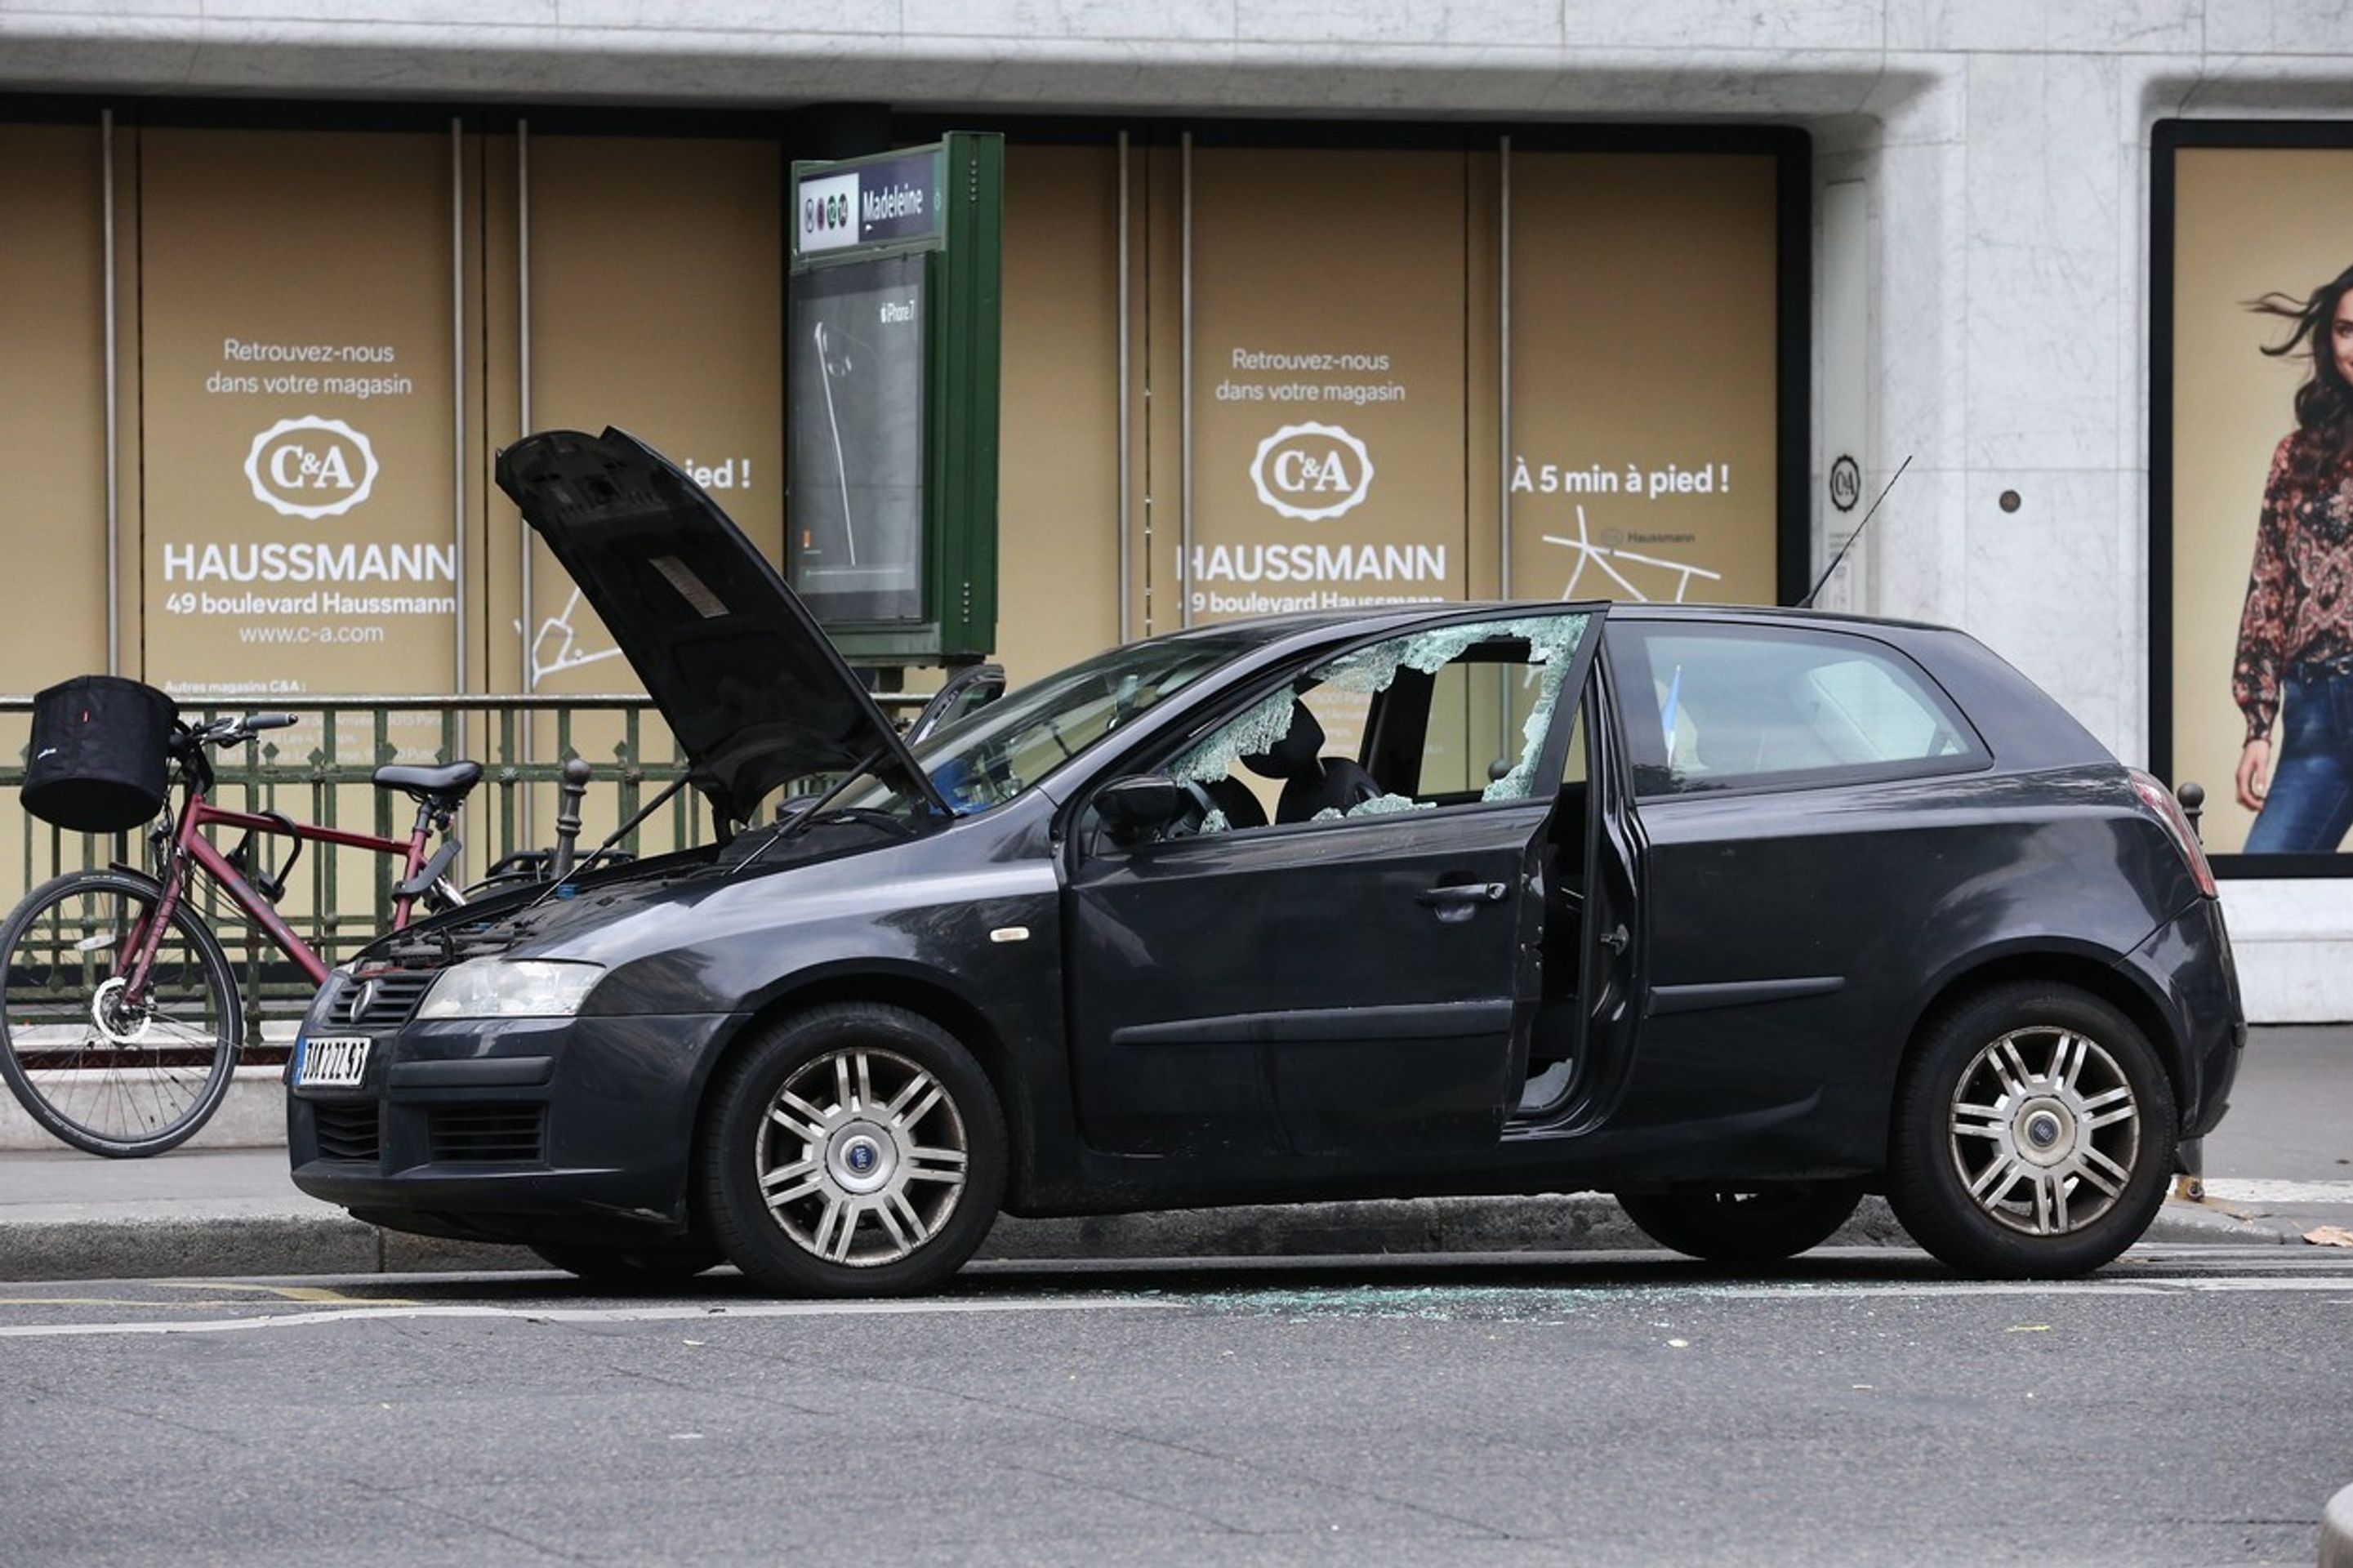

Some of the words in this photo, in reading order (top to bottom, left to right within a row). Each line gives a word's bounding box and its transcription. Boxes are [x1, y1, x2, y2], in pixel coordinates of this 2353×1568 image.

[862, 183, 923, 222] Madeleine
[224, 339, 394, 362] Retrouvez-nous
[1232, 348, 1389, 370] Retrouvez-nous
[207, 372, 259, 394] dans
[263, 375, 319, 394] votre
[323, 373, 412, 399] magasin
[1215, 380, 1263, 400] dans
[1267, 382, 1319, 400] votre
[1324, 381, 1406, 406] magasin
[270, 445, 354, 488] C&A
[685, 458, 733, 488] ied
[1274, 450, 1353, 492] C&A
[1511, 456, 1534, 492] À
[1540, 466, 1558, 492] 5
[1565, 464, 1618, 492] min
[1625, 464, 1643, 492] à
[1648, 463, 1714, 499] pied
[1629, 532, 1696, 543] Haussmann
[164, 544, 456, 581] HAUSSMANN
[166, 594, 196, 613] 49
[202, 593, 317, 612] boulevard
[324, 594, 455, 612] Haussmann
[1210, 591, 1317, 612] boulevard
[240, 626, 384, 644] www.c-a.com
[165, 683, 204, 693] Autres
[209, 683, 265, 694] magasins
[270, 681, 299, 692] C&A
